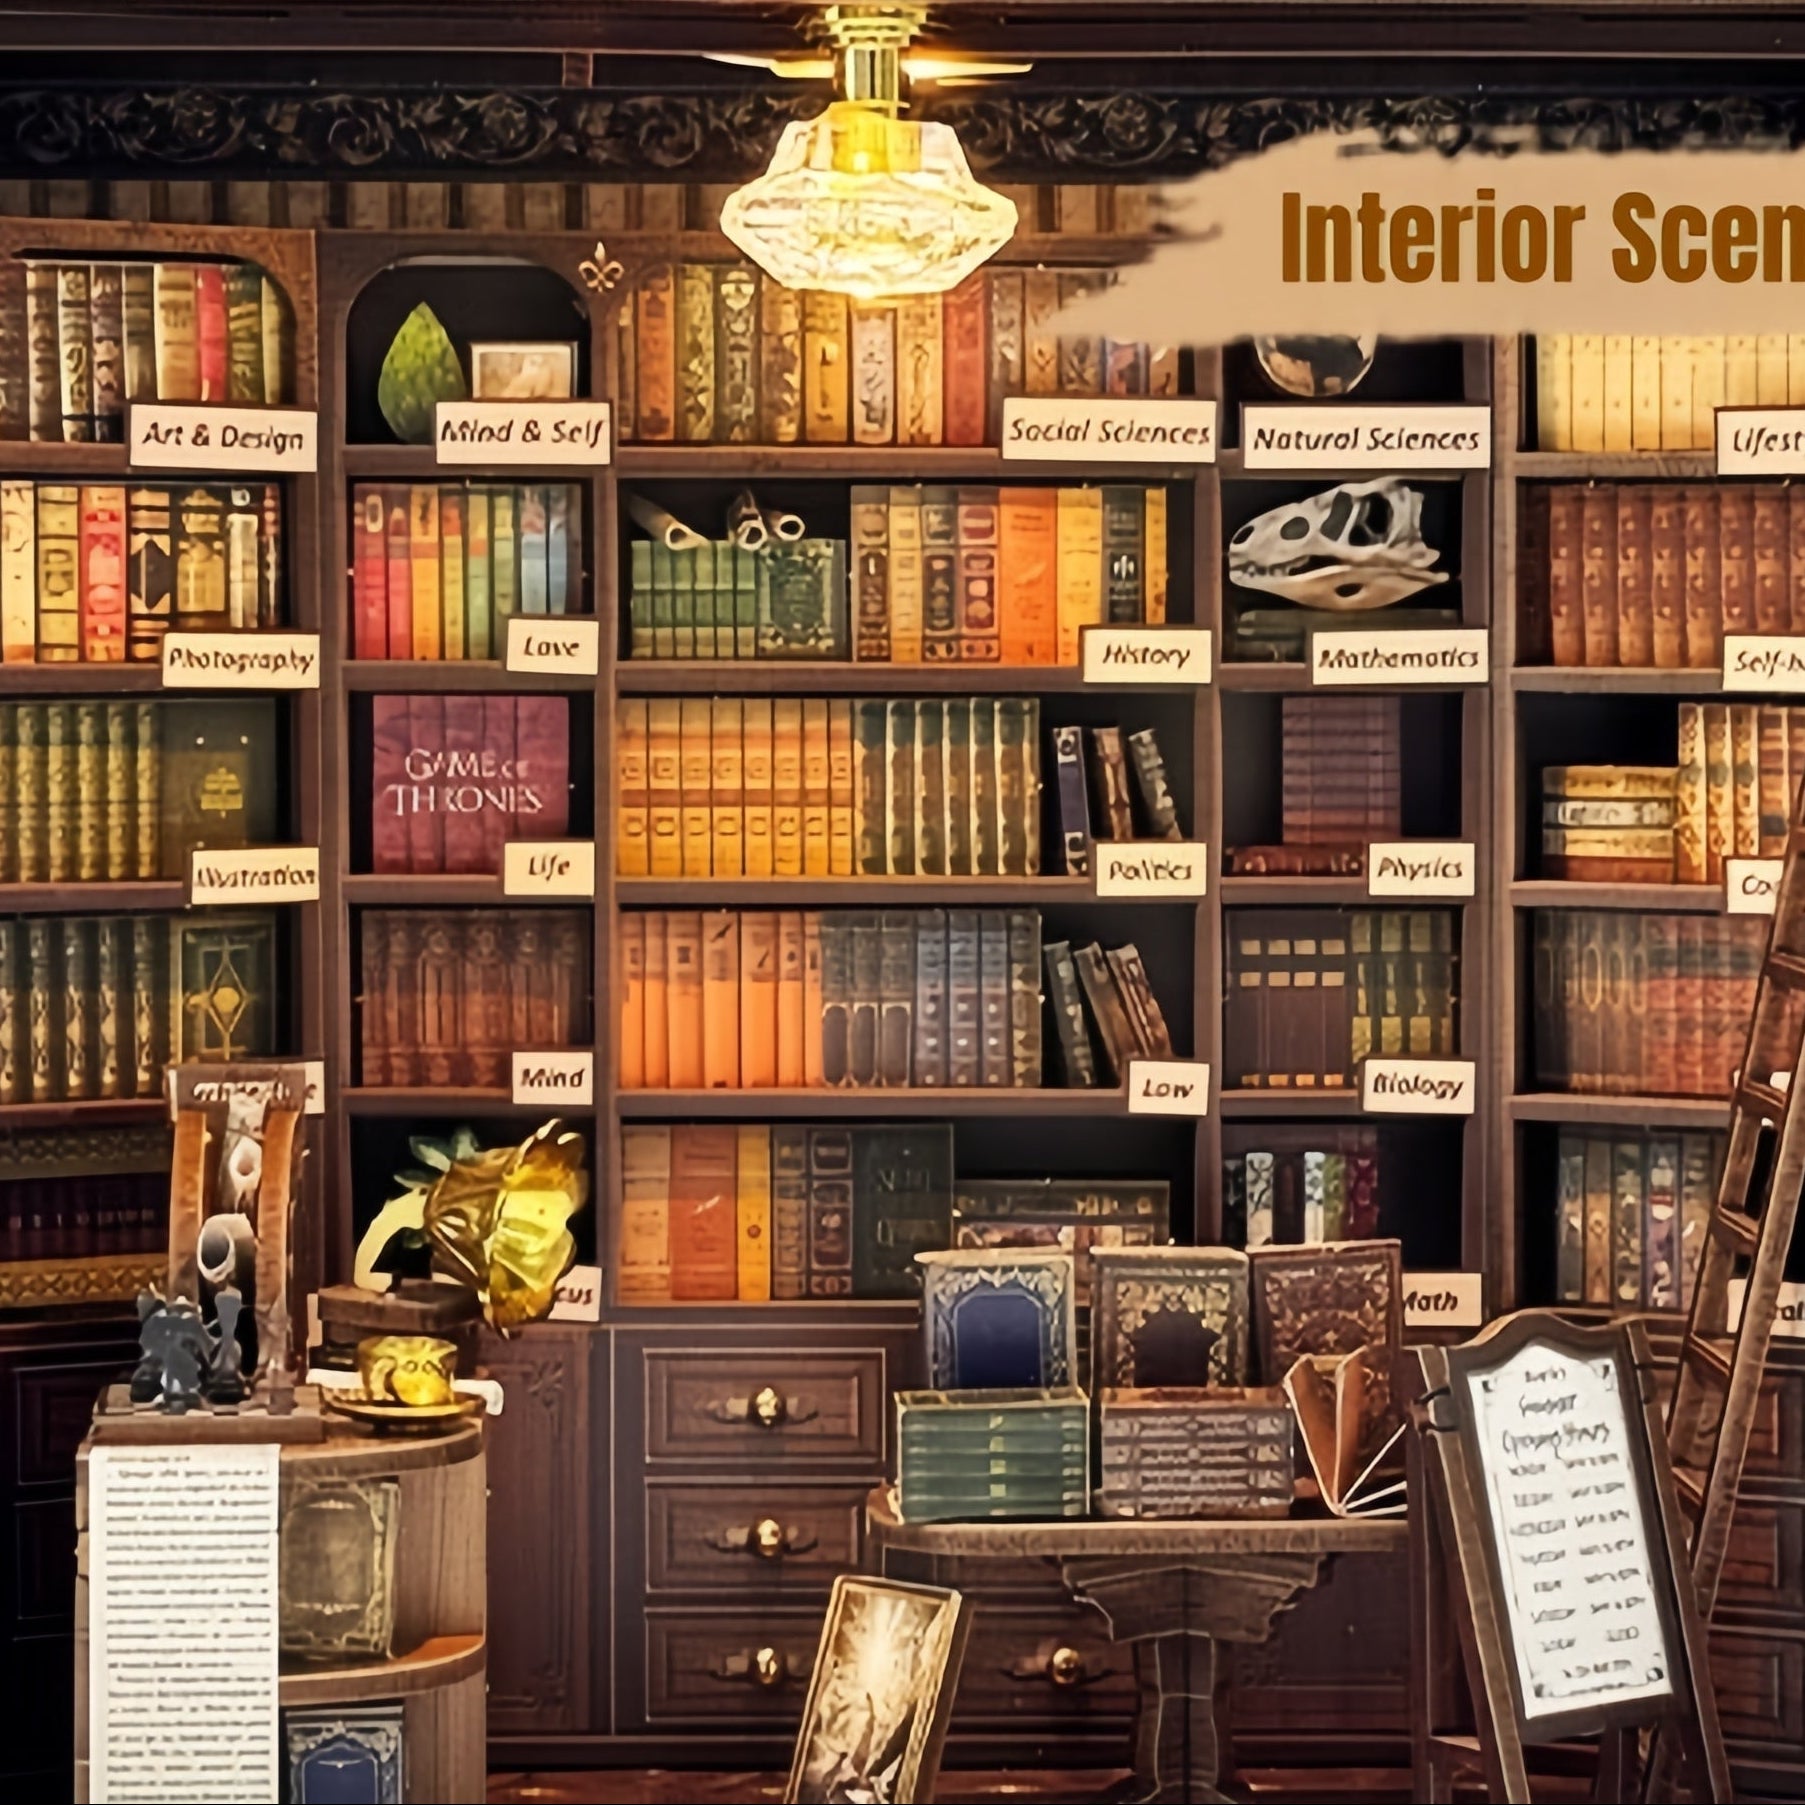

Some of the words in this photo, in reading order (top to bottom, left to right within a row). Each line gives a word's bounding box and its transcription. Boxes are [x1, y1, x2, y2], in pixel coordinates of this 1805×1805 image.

[141, 422, 185, 446] Art
[190, 423, 210, 447] &
[220, 424, 304, 456] Design
[440, 419, 513, 443] Mind
[521, 419, 542, 443] &
[551, 418, 605, 449] Self
[1009, 416, 1091, 443] Social
[1098, 418, 1211, 446] Sciences
[1253, 426, 1360, 451] Natural
[1366, 427, 1481, 451] Sciences
[169, 646, 315, 676] Photography
[523, 636, 581, 658] Love
[1102, 644, 1192, 669] History
[1318, 646, 1480, 669] Mathematics
[405, 748, 496, 782] GAME
[382, 783, 543, 816] THRONES
[528, 854, 571, 882] Life
[1377, 856, 1464, 882] Physics
[521, 1066, 586, 1088] Mind
[1372, 1072, 1465, 1101] Biology
